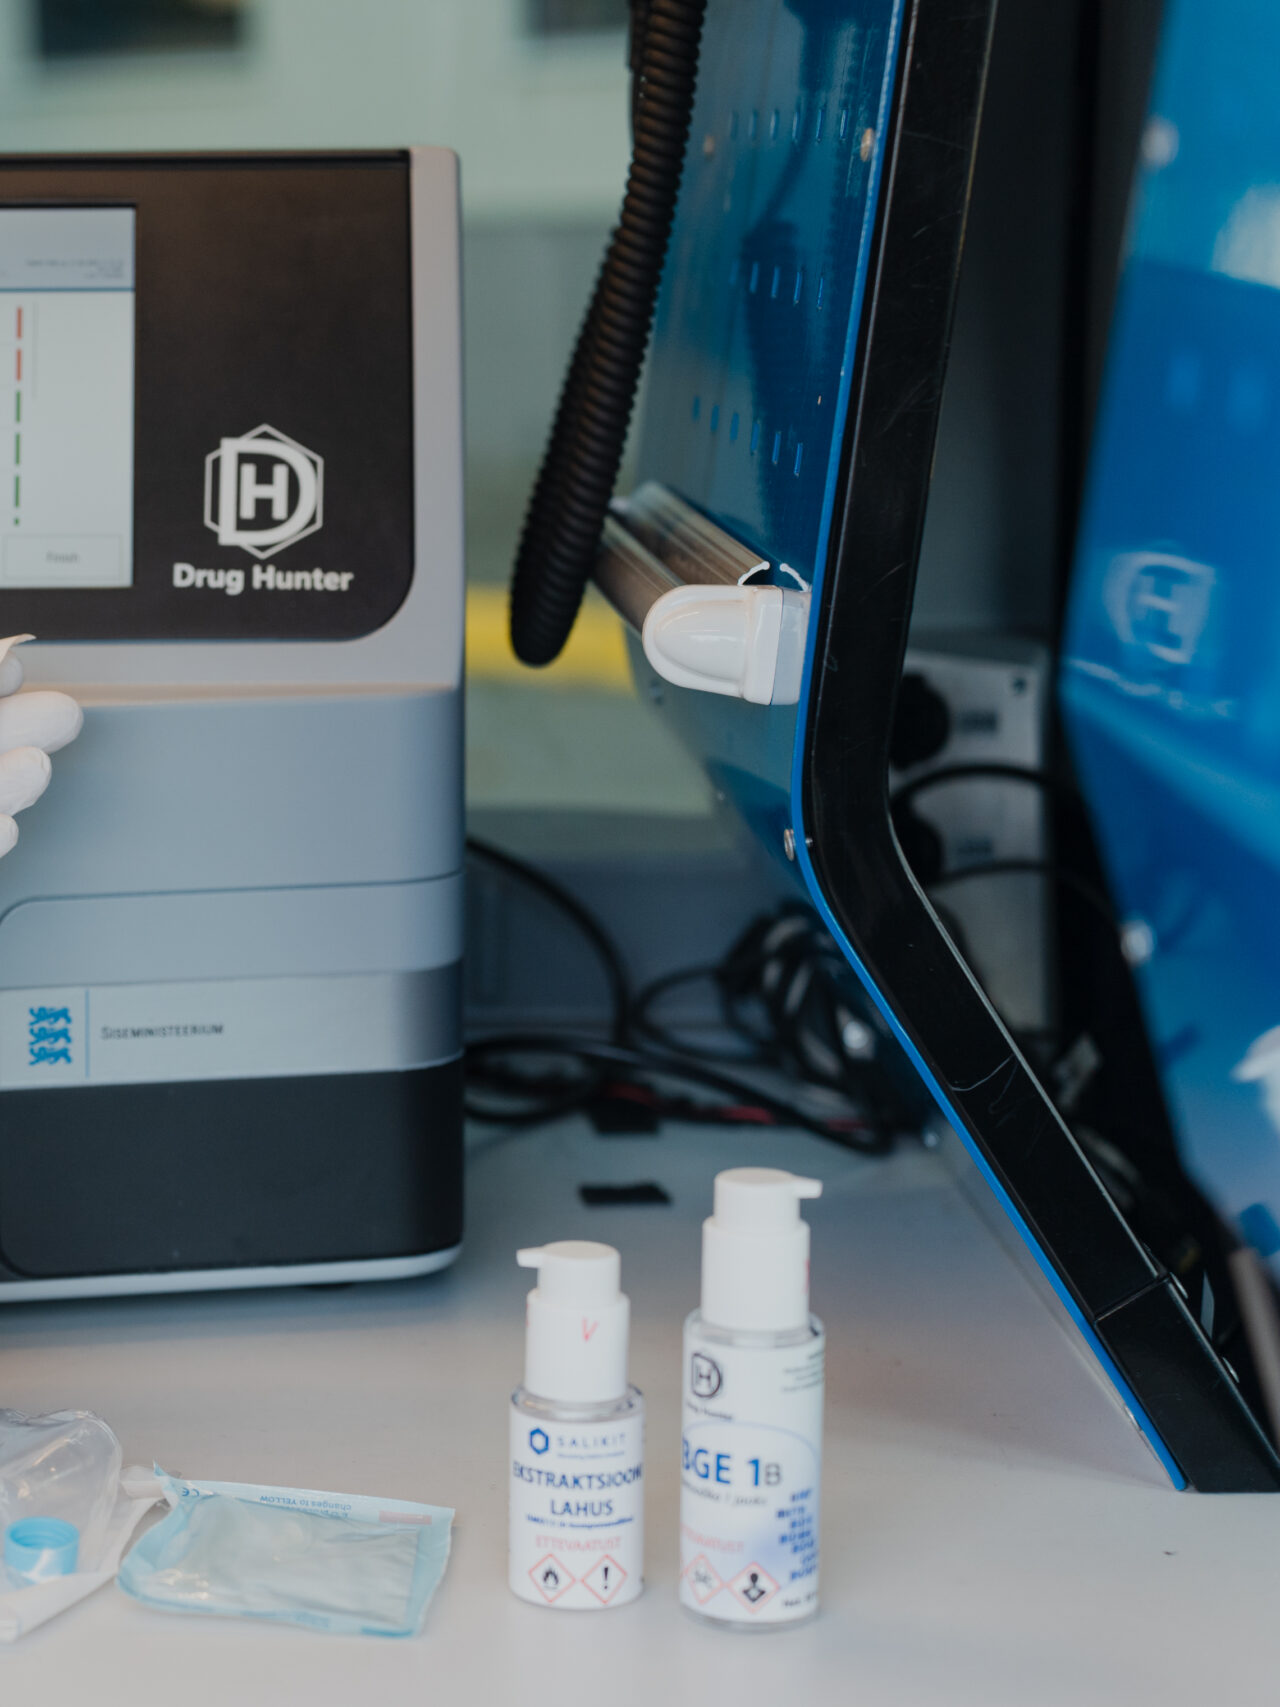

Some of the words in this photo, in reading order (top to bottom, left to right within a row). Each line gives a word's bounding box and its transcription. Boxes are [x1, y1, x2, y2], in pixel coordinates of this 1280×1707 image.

[173, 562, 245, 595] Drug
[252, 564, 354, 591] Hunter
[556, 1432, 627, 1449] SALIKIT
[259, 1495, 298, 1506] YELLOW
[310, 1501, 352, 1512] changes
[550, 1500, 614, 1517] LAHUS
